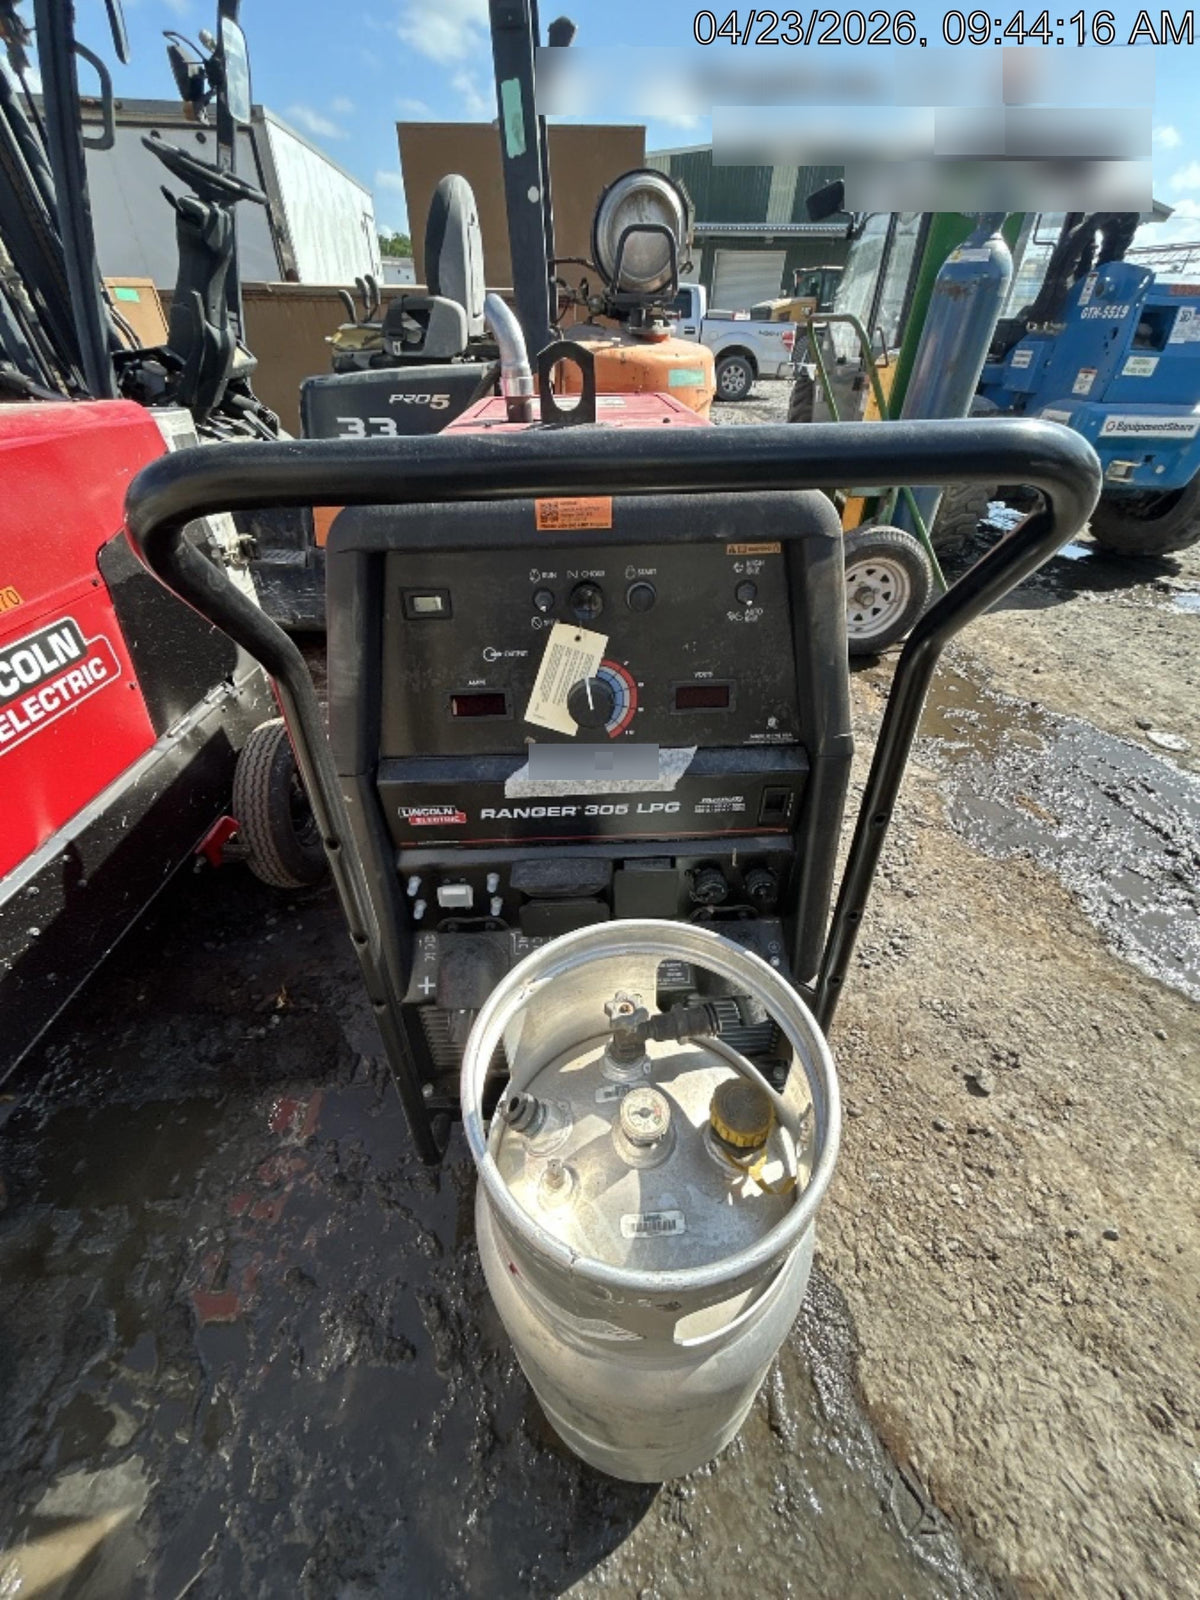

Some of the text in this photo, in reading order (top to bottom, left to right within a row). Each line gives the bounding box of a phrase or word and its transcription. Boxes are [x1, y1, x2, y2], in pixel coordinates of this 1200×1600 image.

[1080, 304, 1131, 320] GTH-5519
[336, 417, 399, 440] 33
[1115, 420, 1195, 433] EquipmentShare
[0, 657, 108, 743] ELECTRIC
[401, 806, 454, 817] LINCOLN
[480, 805, 577, 820] RANGER
[584, 803, 630, 816] 305
[636, 801, 681, 814] LPG
